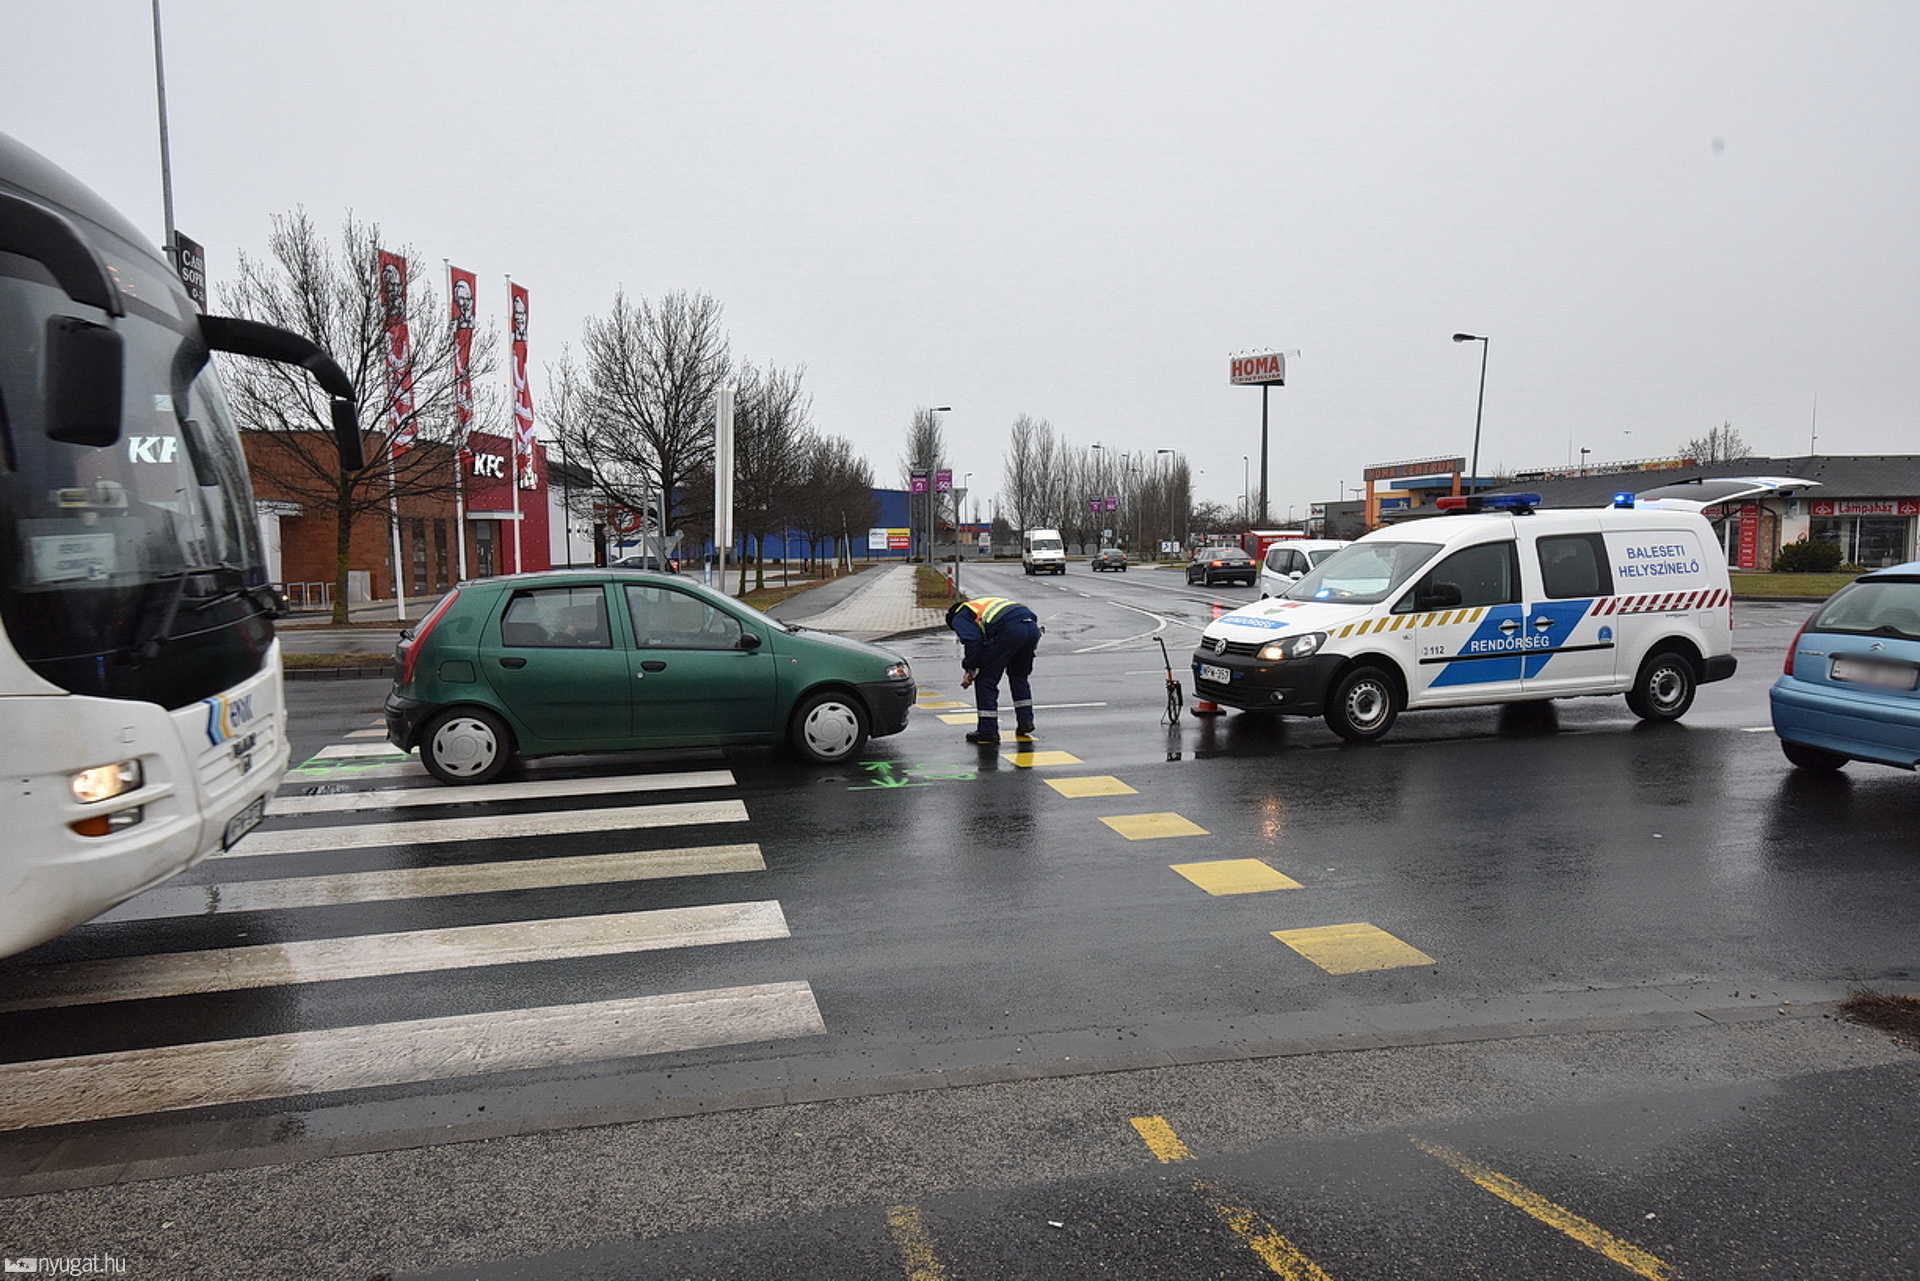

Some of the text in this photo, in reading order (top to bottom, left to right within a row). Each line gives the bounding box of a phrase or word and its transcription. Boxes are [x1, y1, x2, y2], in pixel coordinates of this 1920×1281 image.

[1231, 355, 1280, 377] HOMA
[473, 453, 505, 479] KFC
[1626, 545, 1686, 560] BALESETI
[1619, 559, 1700, 577] HELYSZÍNELŐ
[1430, 635, 1550, 655] 112 RENDŐRSÉG
